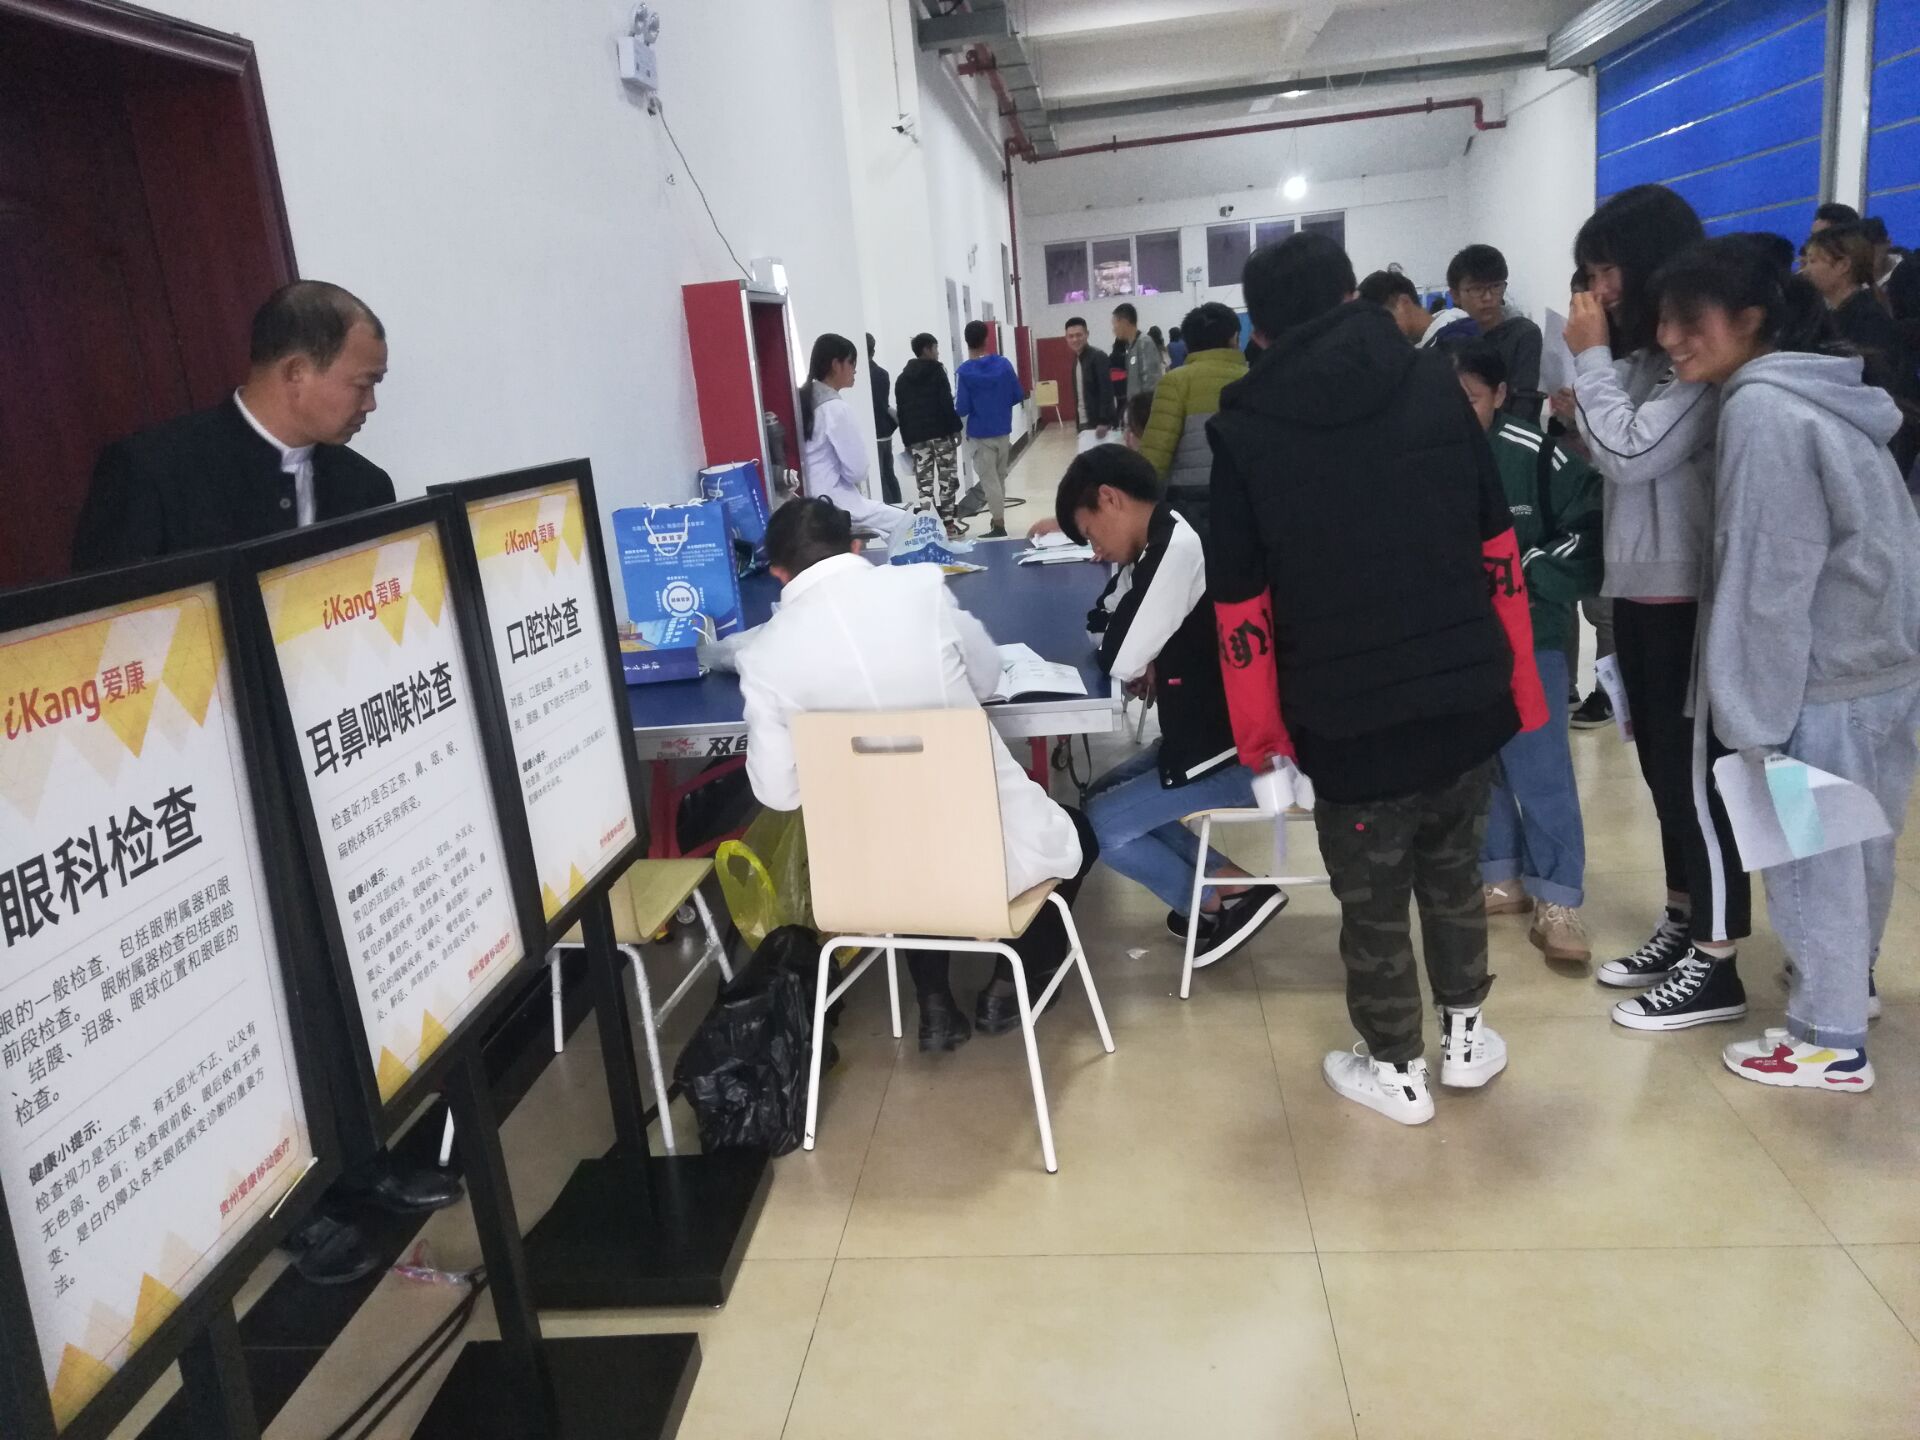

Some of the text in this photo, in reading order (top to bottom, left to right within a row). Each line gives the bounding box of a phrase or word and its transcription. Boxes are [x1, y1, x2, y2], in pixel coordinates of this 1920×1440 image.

[506, 597, 582, 664] 口腔检查
[306, 661, 456, 777] 耳鼻咽喉检查
[0, 784, 203, 947] 眼科检查
[15, 1088, 61, 1128] 检查。
